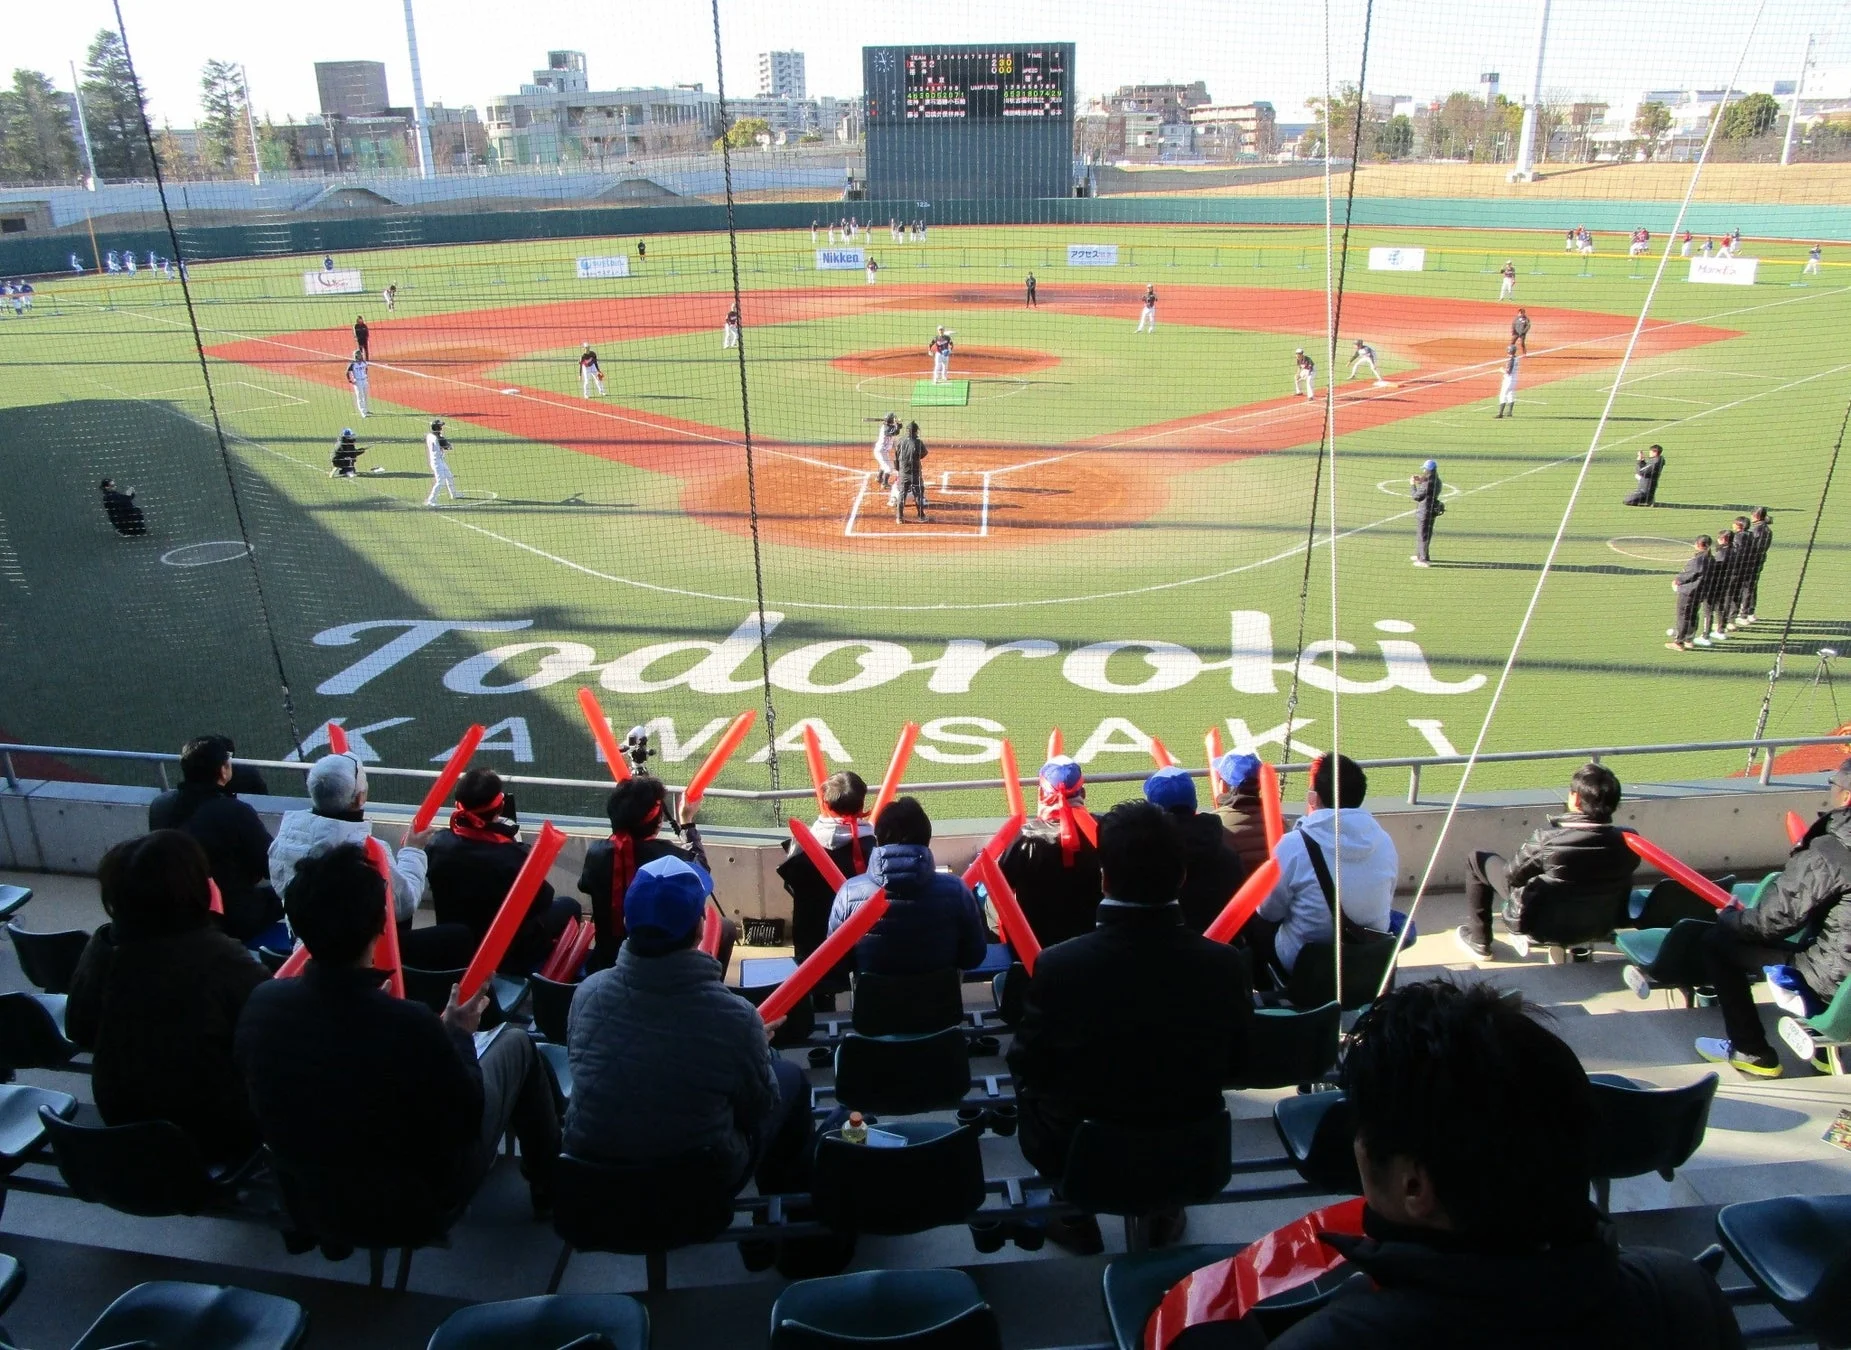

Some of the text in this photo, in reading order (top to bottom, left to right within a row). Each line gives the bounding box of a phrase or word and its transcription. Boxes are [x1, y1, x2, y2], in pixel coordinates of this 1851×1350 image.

[823, 252, 859, 263] Nikken
[312, 610, 1487, 695] Todoroki
[282, 716, 1462, 764] KAWASAKI
